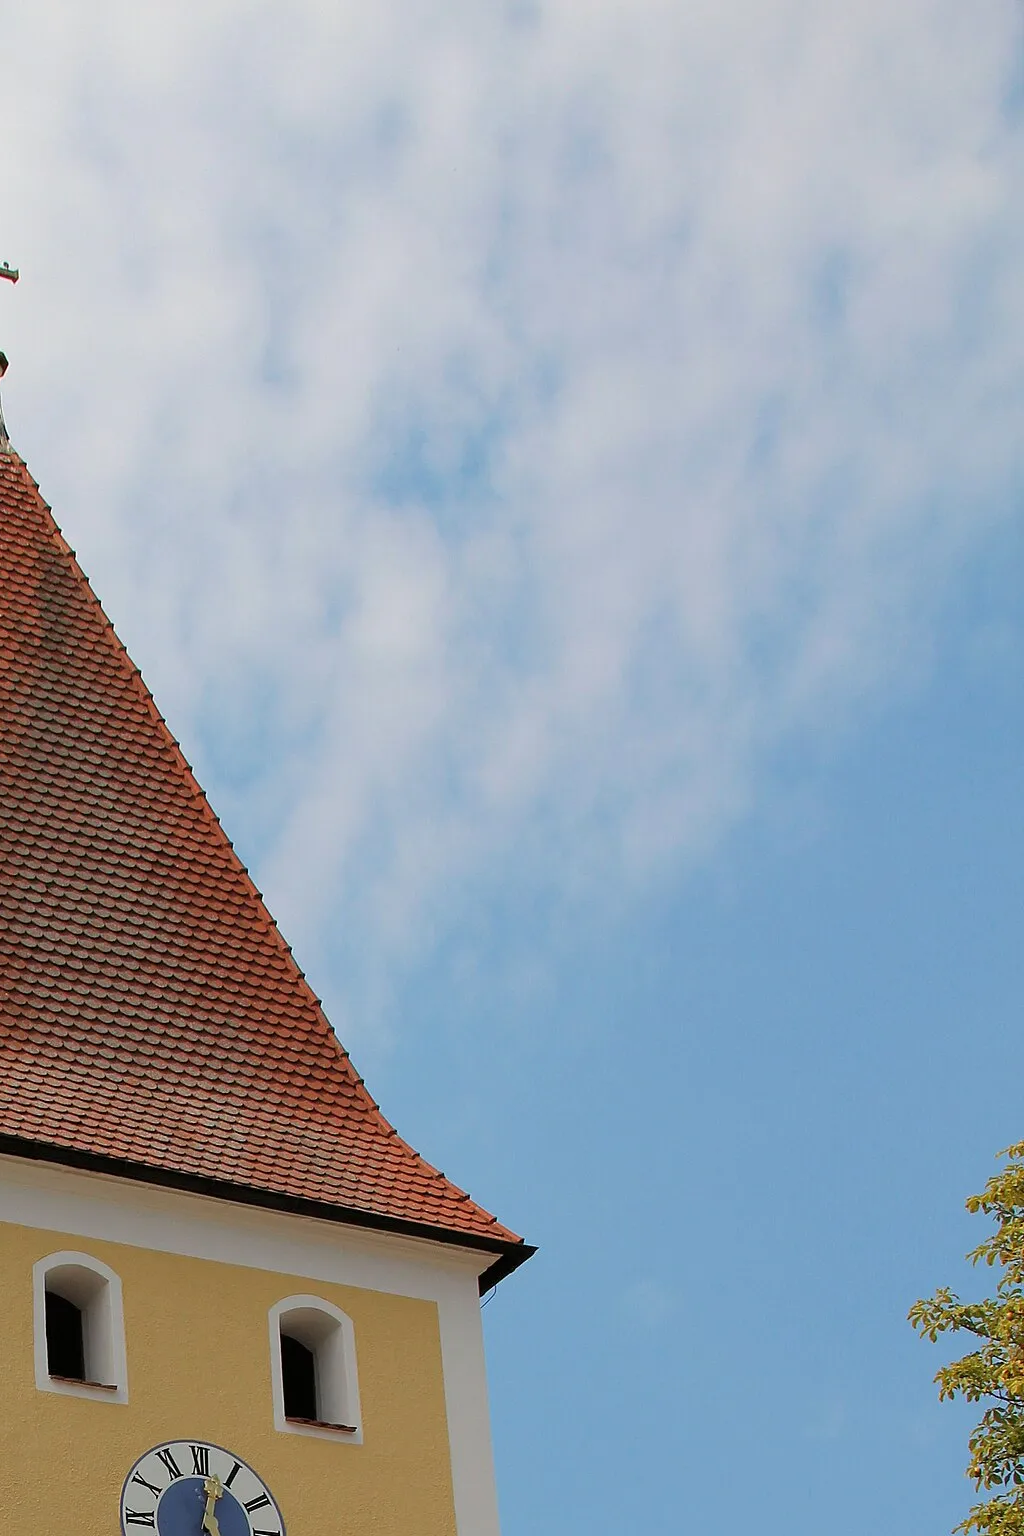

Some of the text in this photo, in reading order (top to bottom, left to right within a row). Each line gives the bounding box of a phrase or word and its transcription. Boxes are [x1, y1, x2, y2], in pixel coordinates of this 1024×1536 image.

[155, 1448, 184, 1481] XI
[189, 1446, 210, 1477] XII
[223, 1461, 243, 1489] I
[131, 1471, 162, 1499] X
[243, 1492, 272, 1514] II
[126, 1507, 155, 1528] IX
